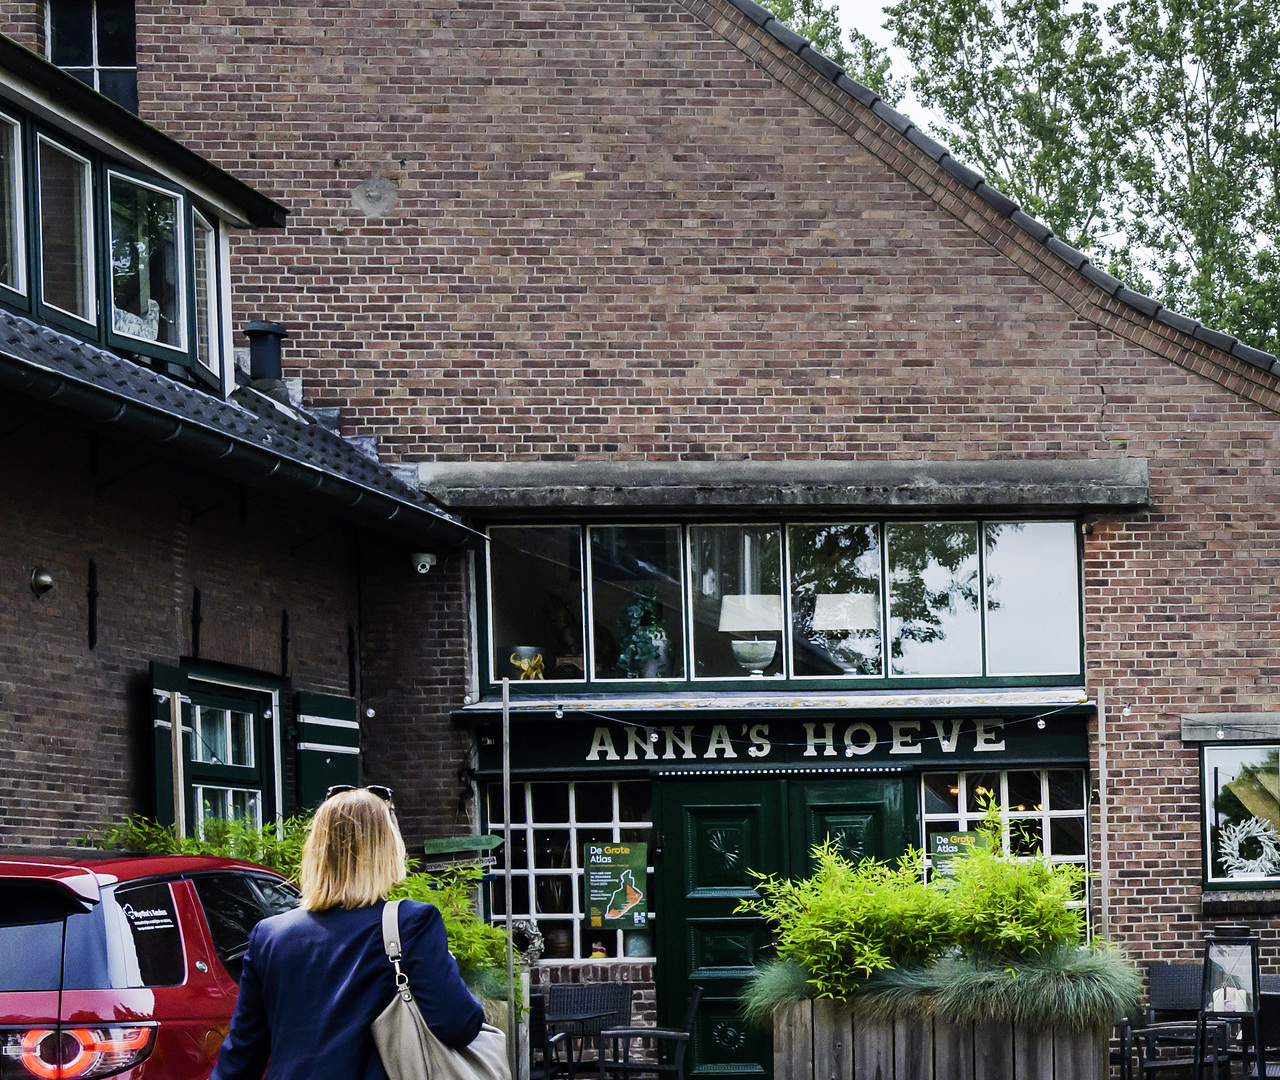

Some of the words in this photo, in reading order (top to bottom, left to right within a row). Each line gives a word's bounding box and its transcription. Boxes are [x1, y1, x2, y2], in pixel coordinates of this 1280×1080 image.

[586, 723, 771, 760] ANNA'S
[803, 719, 1006, 757] HOEVE
[936, 836, 948, 844] De
[590, 846, 602, 854] De
[604, 846, 630, 854] Grote
[936, 844, 959, 853] Atlas
[590, 855, 612, 863] Atlas
